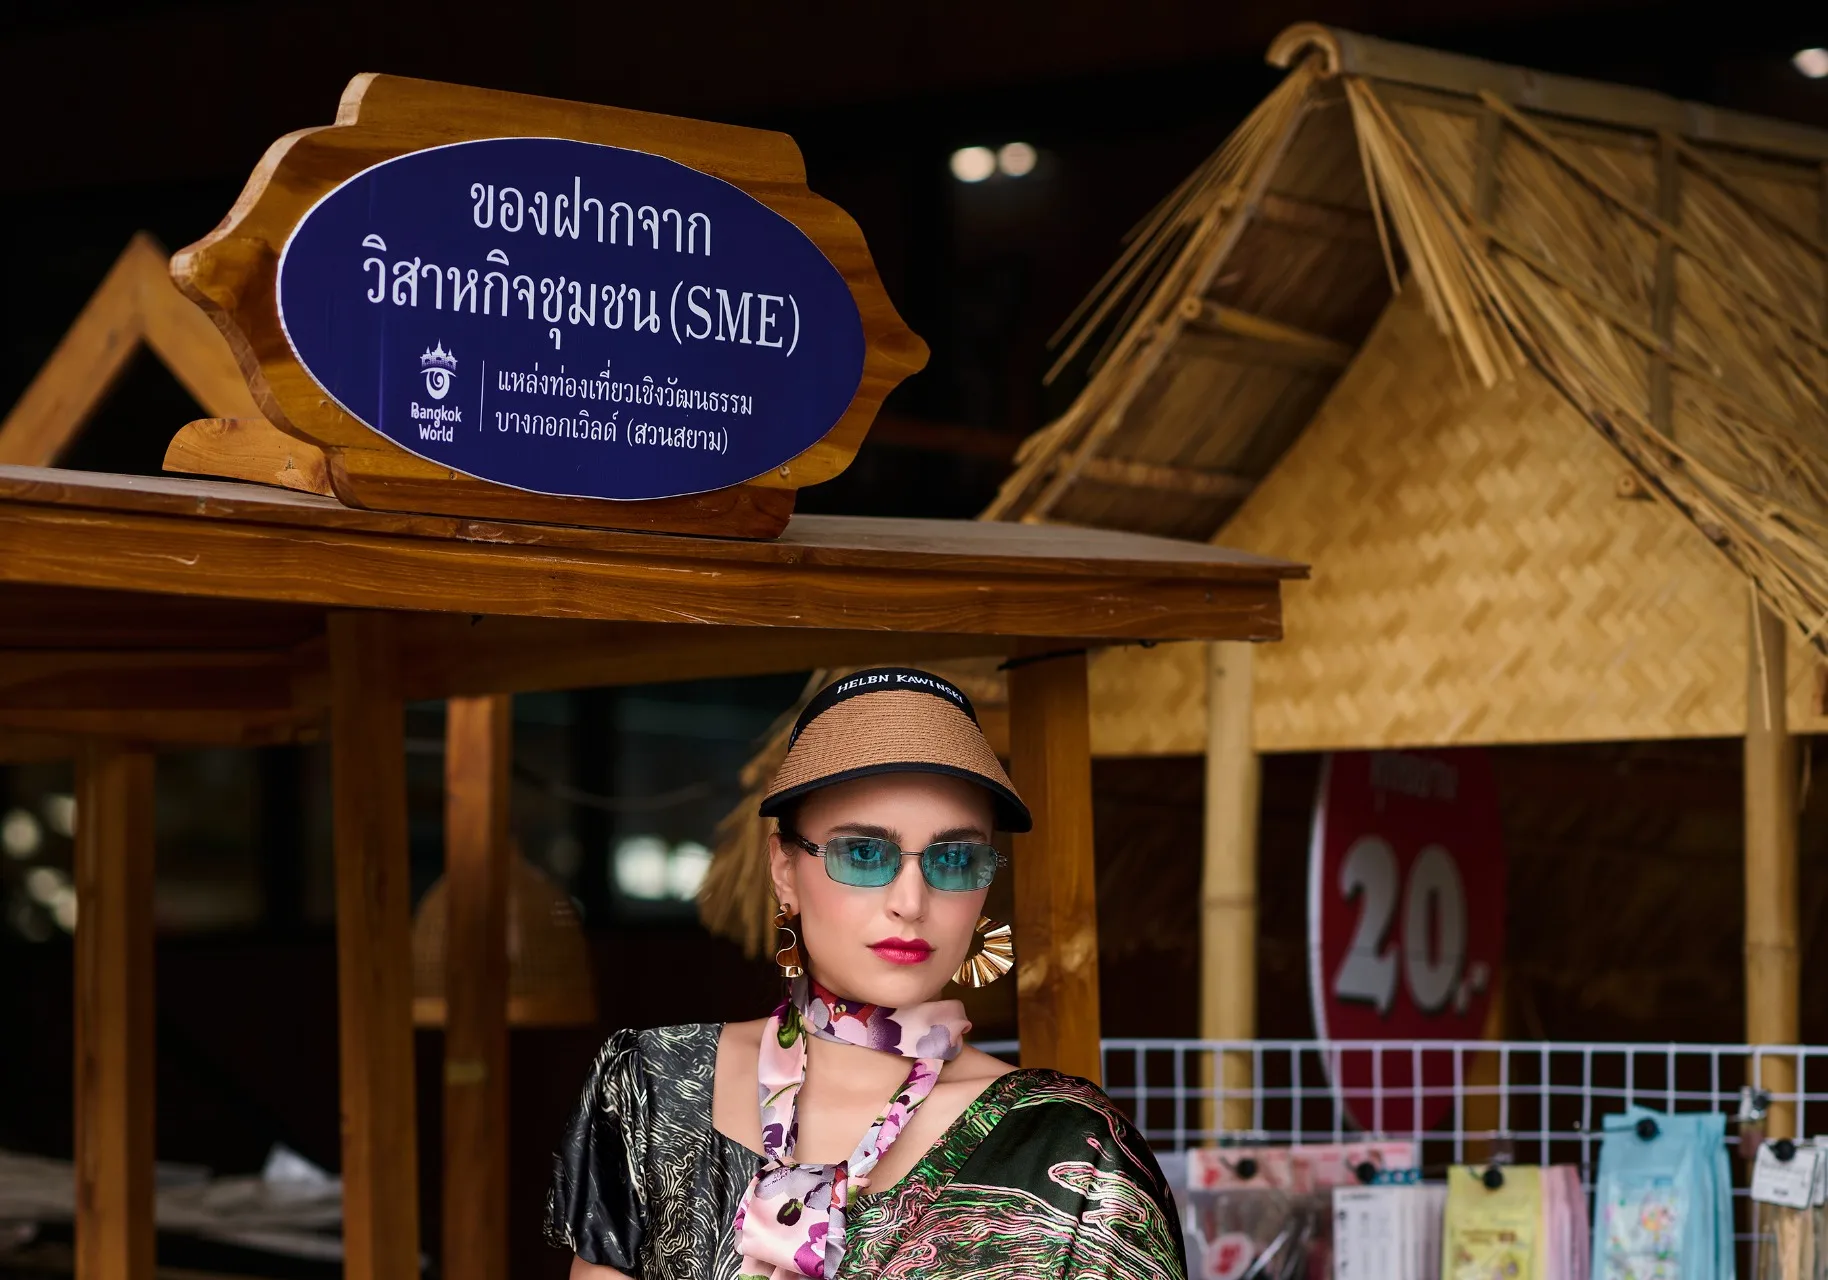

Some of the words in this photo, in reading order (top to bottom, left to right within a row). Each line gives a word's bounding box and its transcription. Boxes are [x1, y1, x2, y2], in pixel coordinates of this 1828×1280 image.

[470, 175, 712, 257] ของฝากจาก
[361, 233, 661, 351] วิสาหกิจชุมชน
[669, 280, 801, 358] (SME)
[498, 359, 754, 416] แหล่งท่องเที่ยวเชิงวัฒนธรรม
[410, 401, 463, 428] Bangkok
[418, 423, 454, 443] World
[495, 409, 618, 442] บางกอกเวิลด์
[626, 417, 729, 455] (สวนสยาม)
